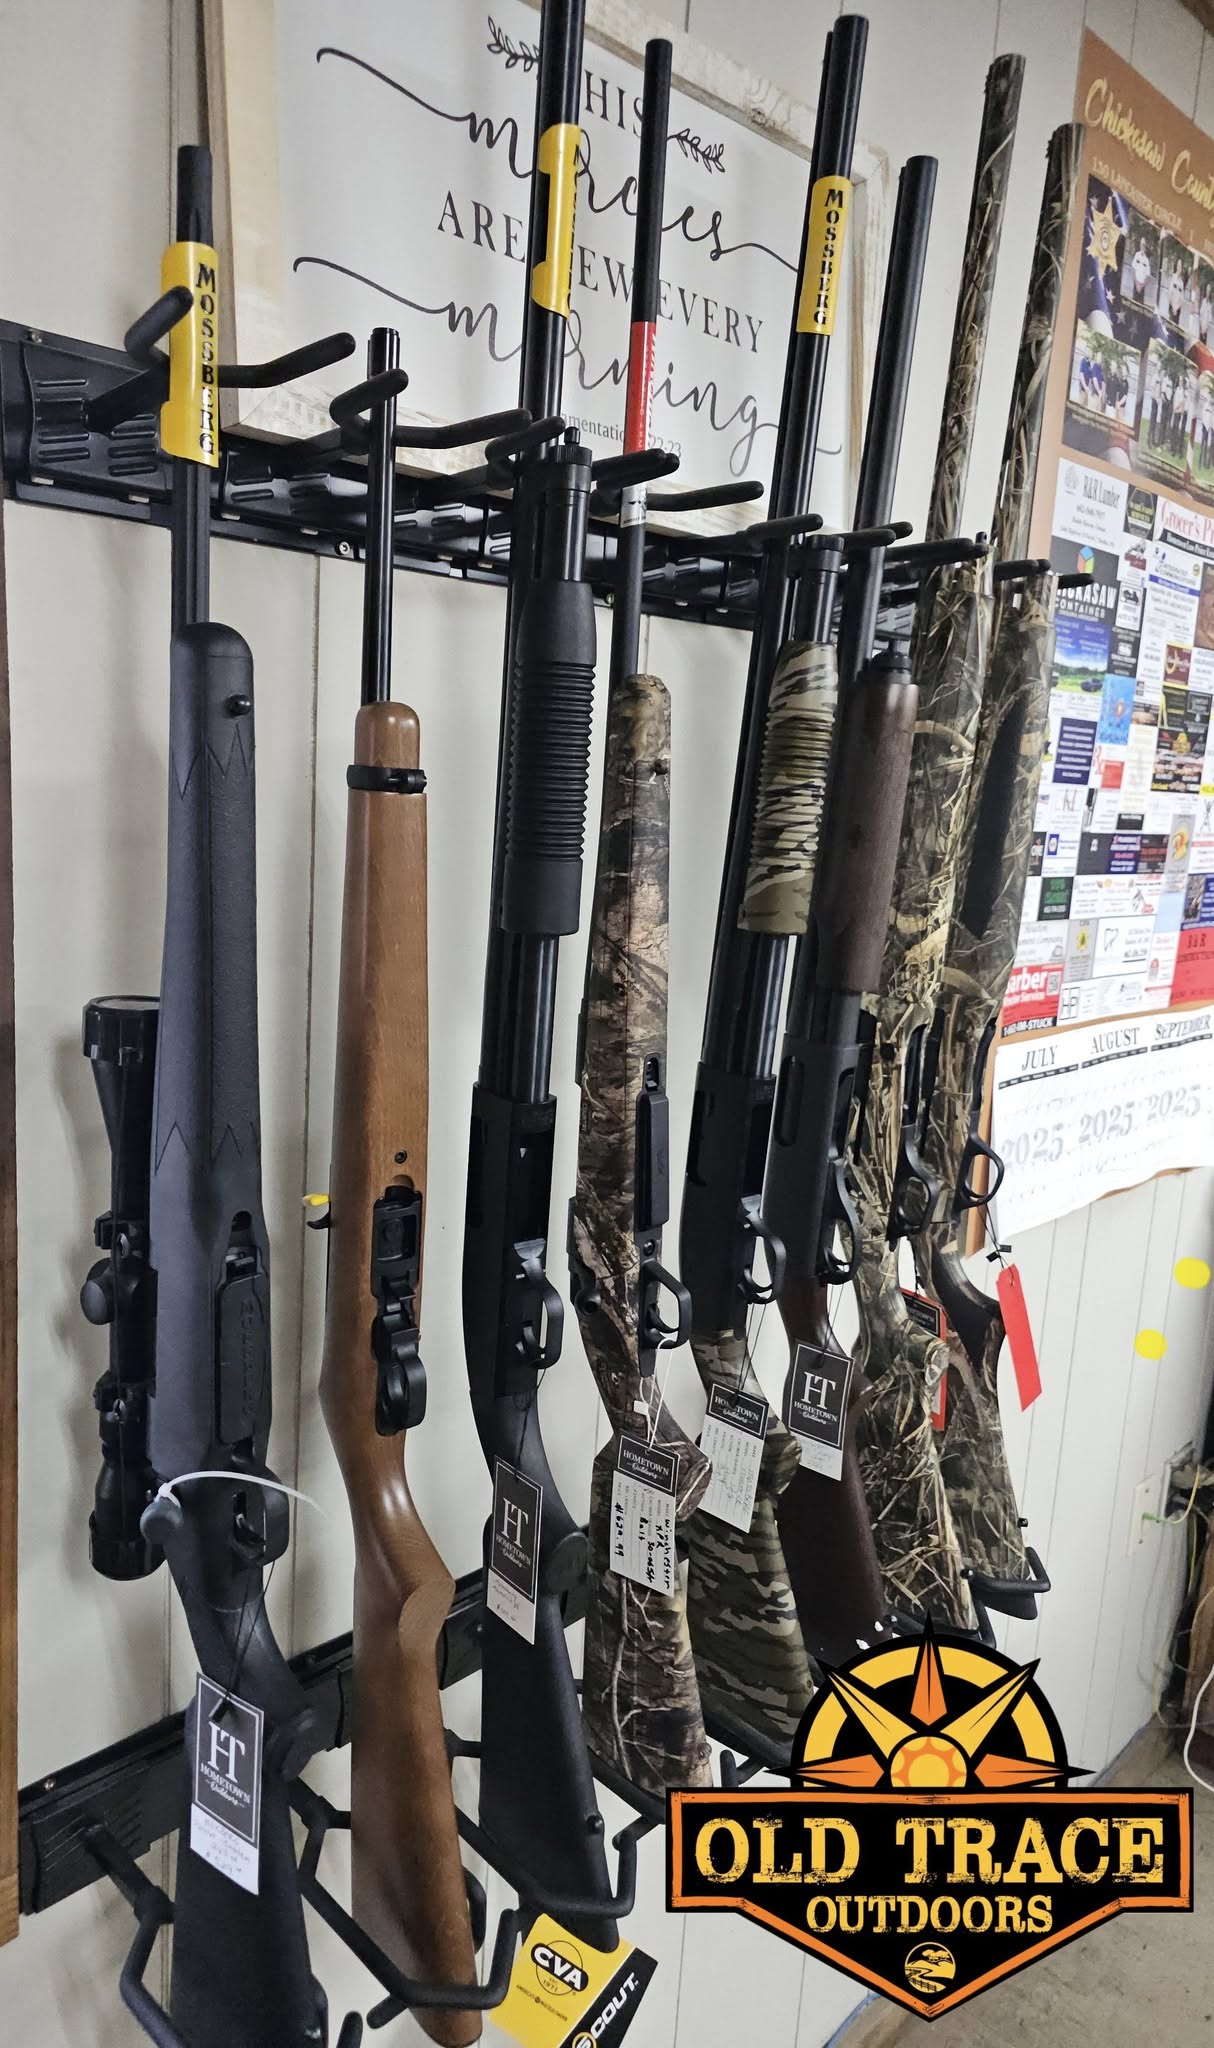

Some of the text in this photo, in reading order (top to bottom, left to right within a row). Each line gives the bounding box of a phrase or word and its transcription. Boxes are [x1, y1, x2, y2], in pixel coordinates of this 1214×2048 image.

[584, 69, 643, 138] HIS
[1085, 77, 1167, 172] Chickasaw
[437, 190, 526, 264] ARE
[577, 244, 635, 303] EW
[657, 279, 763, 353] EVERY
[814, 189, 843, 325] MOSSBERG
[196, 262, 216, 456] MOSSBERG
[1007, 967, 1048, 994] arber
[1090, 1027, 1140, 1055] AUGUST
[1155, 1014, 1212, 1041] SEPTEMBER
[1021, 1045, 1058, 1071] JULY
[1078, 1100, 1136, 1144] 2025
[1147, 1084, 1201, 1121] 2025
[1001, 1122, 1064, 1170] 2025
[715, 1396, 760, 1421] HOTOWN
[794, 1400, 838, 1422] HOMETOWN
[801, 1371, 836, 1410] HT
[623, 1449, 669, 1476] HOMETOWN
[501, 1498, 529, 1548] HT
[496, 1533, 531, 1567] HOMETOWN
[207, 1721, 245, 1783] HT
[200, 1762, 251, 1804] HOMETOWN
[534, 1947, 582, 1990] CVA
